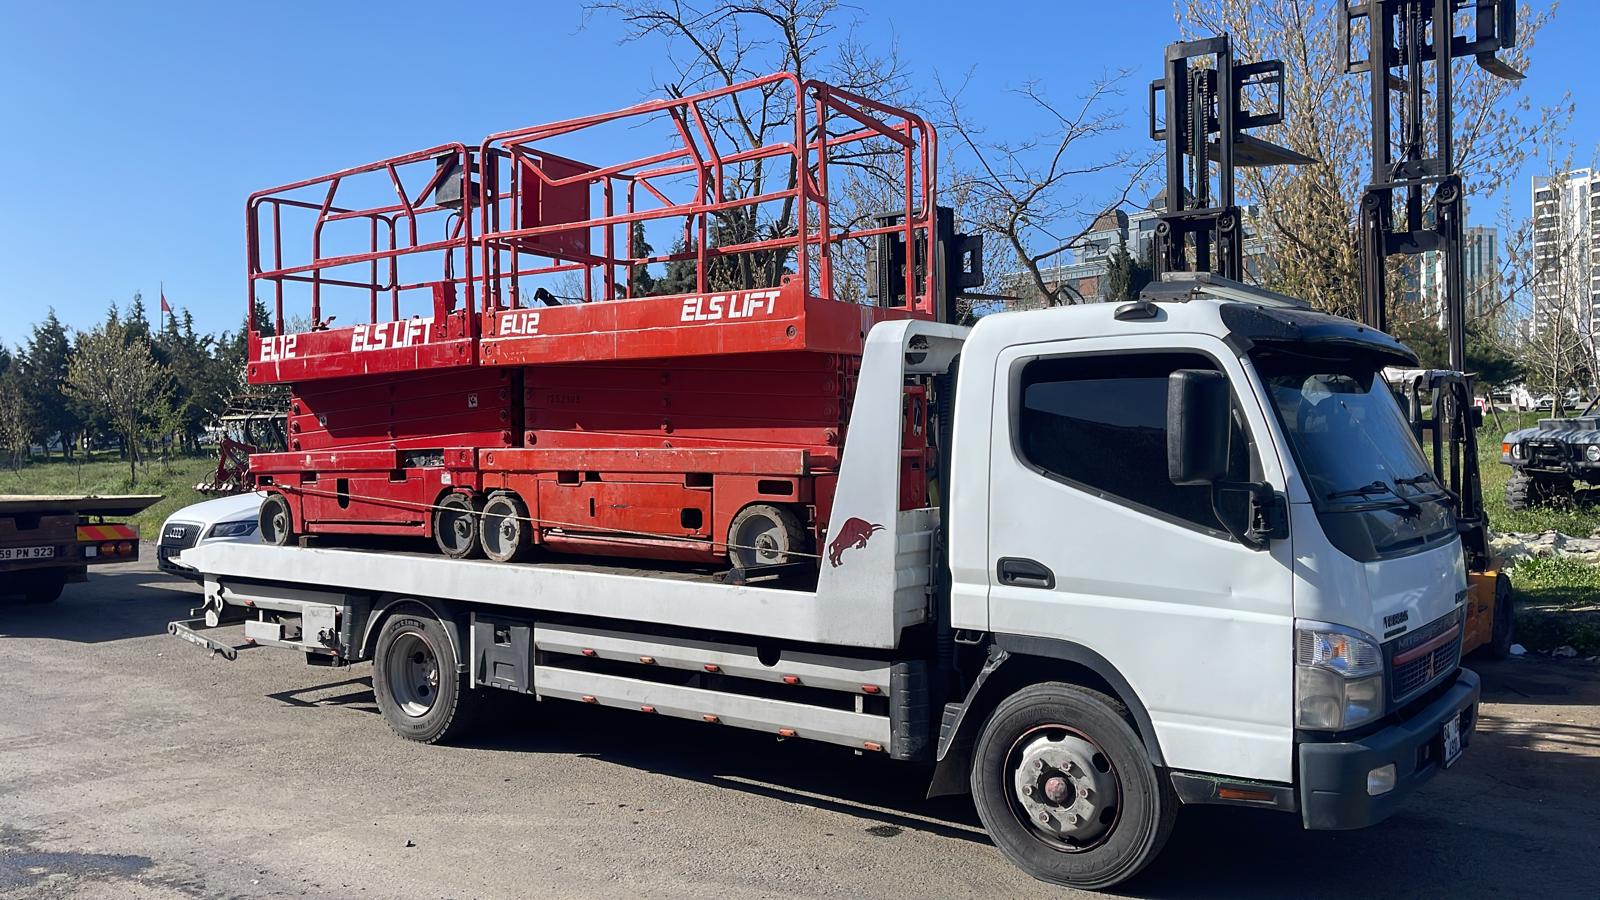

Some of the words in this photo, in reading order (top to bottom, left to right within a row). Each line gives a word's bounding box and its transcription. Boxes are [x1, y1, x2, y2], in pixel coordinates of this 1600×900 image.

[681, 296, 725, 321] ELS
[728, 291, 781, 318] LIFT
[351, 324, 389, 352] ELS
[392, 317, 435, 348] LIFT
[500, 312, 540, 335] EL12
[260, 334, 297, 362] EL12
[16, 548, 29, 558] PN
[34, 547, 53, 557] 923
